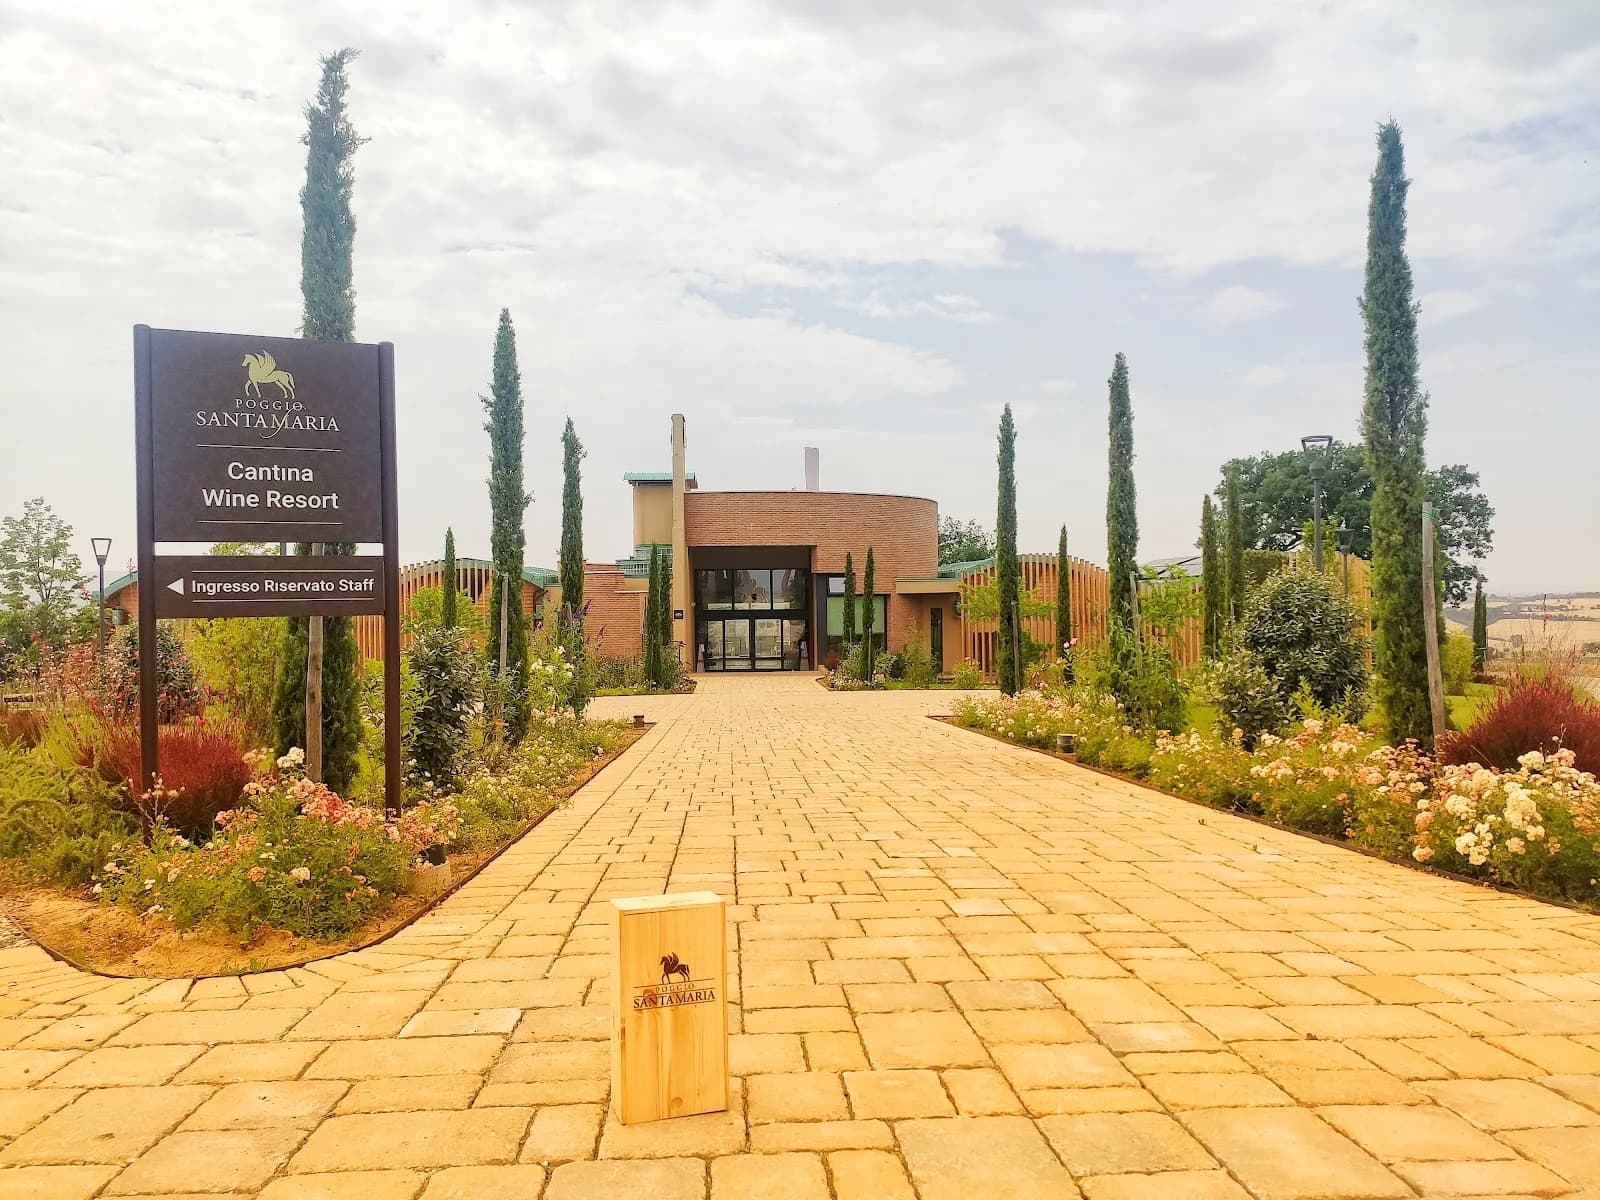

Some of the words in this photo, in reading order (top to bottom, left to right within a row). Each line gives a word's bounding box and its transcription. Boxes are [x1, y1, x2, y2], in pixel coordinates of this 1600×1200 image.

[235, 399, 304, 411] POGGIO
[227, 462, 314, 482] Cantina
[202, 488, 260, 508] Wine
[266, 490, 340, 509] Resort
[191, 580, 260, 594] Ingresso
[264, 578, 335, 593] Riservato
[338, 578, 375, 592] Staff
[633, 990, 716, 1009] SANTAMARIA
